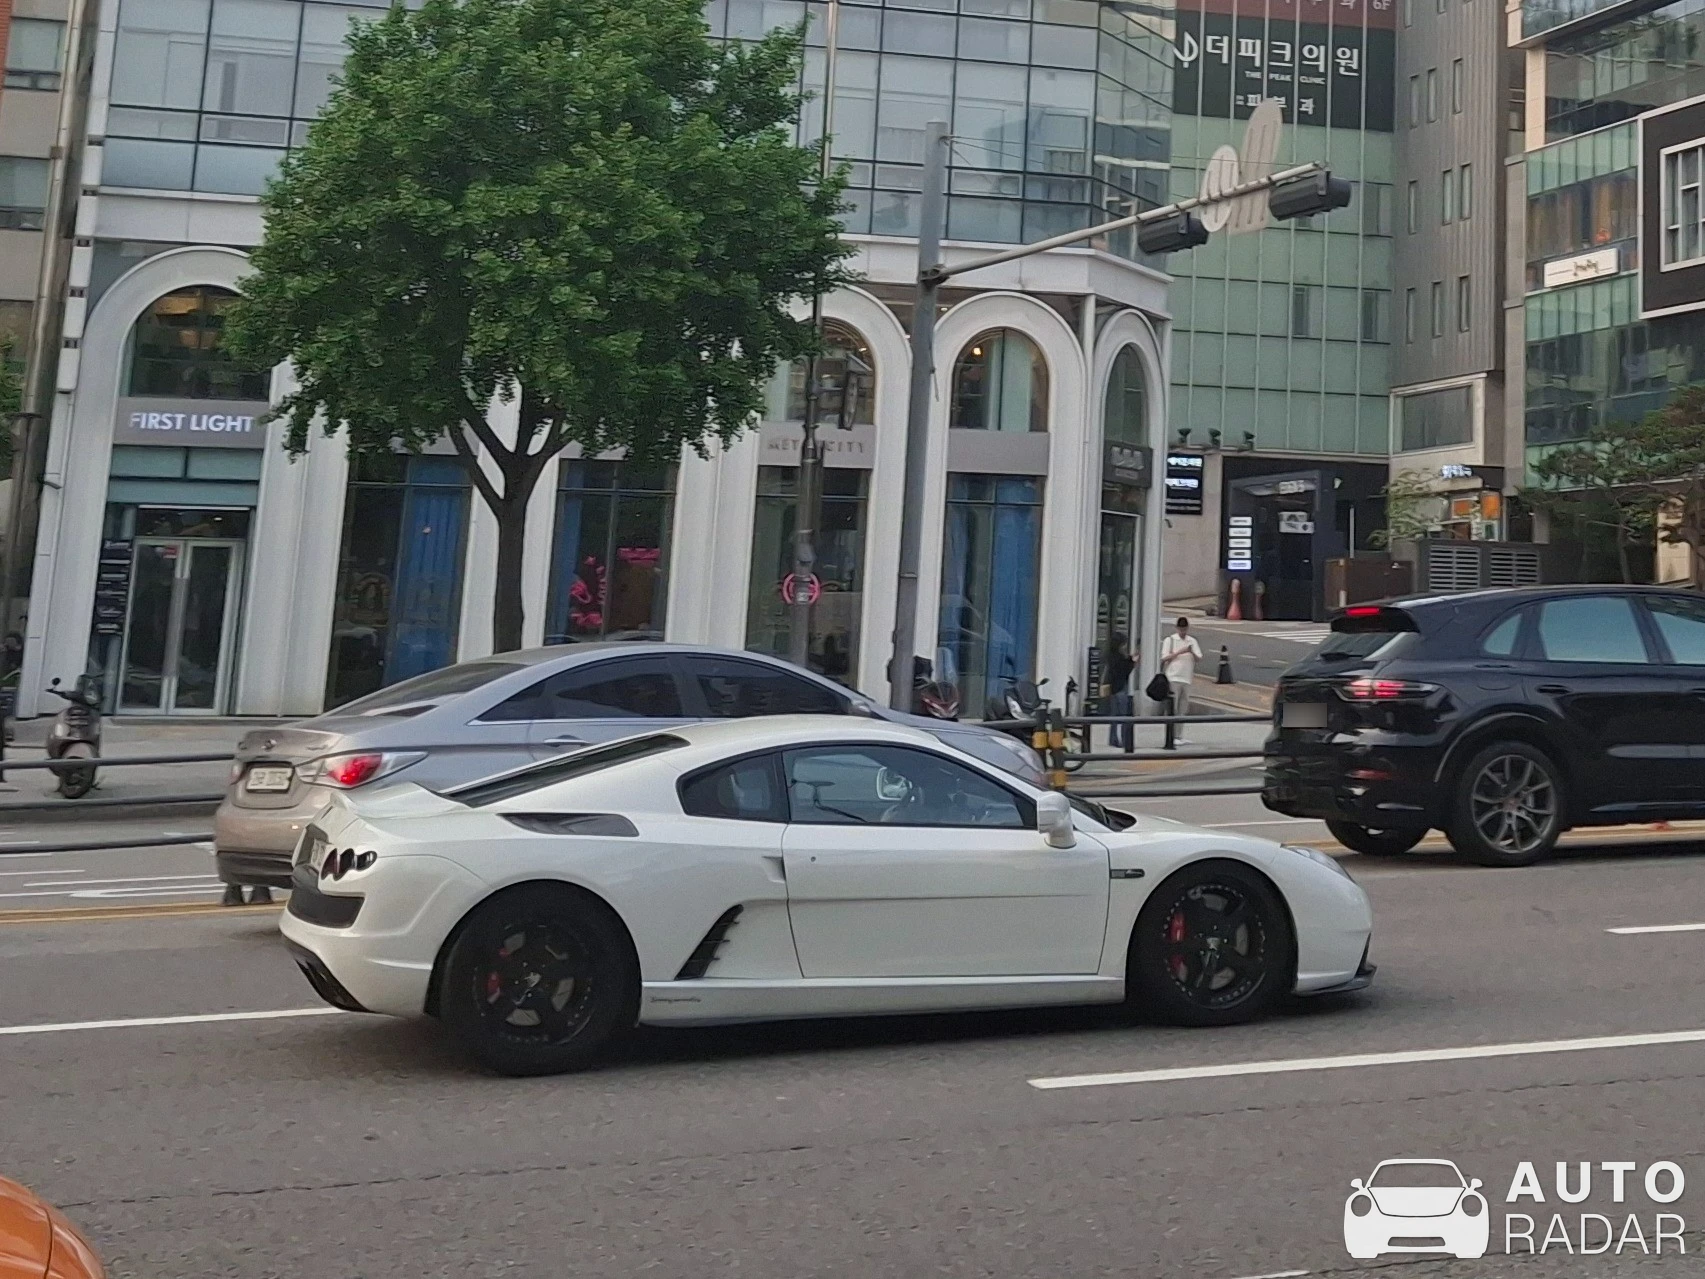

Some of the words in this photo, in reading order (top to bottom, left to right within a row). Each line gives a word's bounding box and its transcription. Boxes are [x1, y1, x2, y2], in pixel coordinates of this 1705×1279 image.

[1206, 35, 1359, 76] 더피크의원
[1269, 73, 1292, 82] PEAK
[130, 412, 186, 430] FIRST
[190, 414, 254, 432] LIGHT
